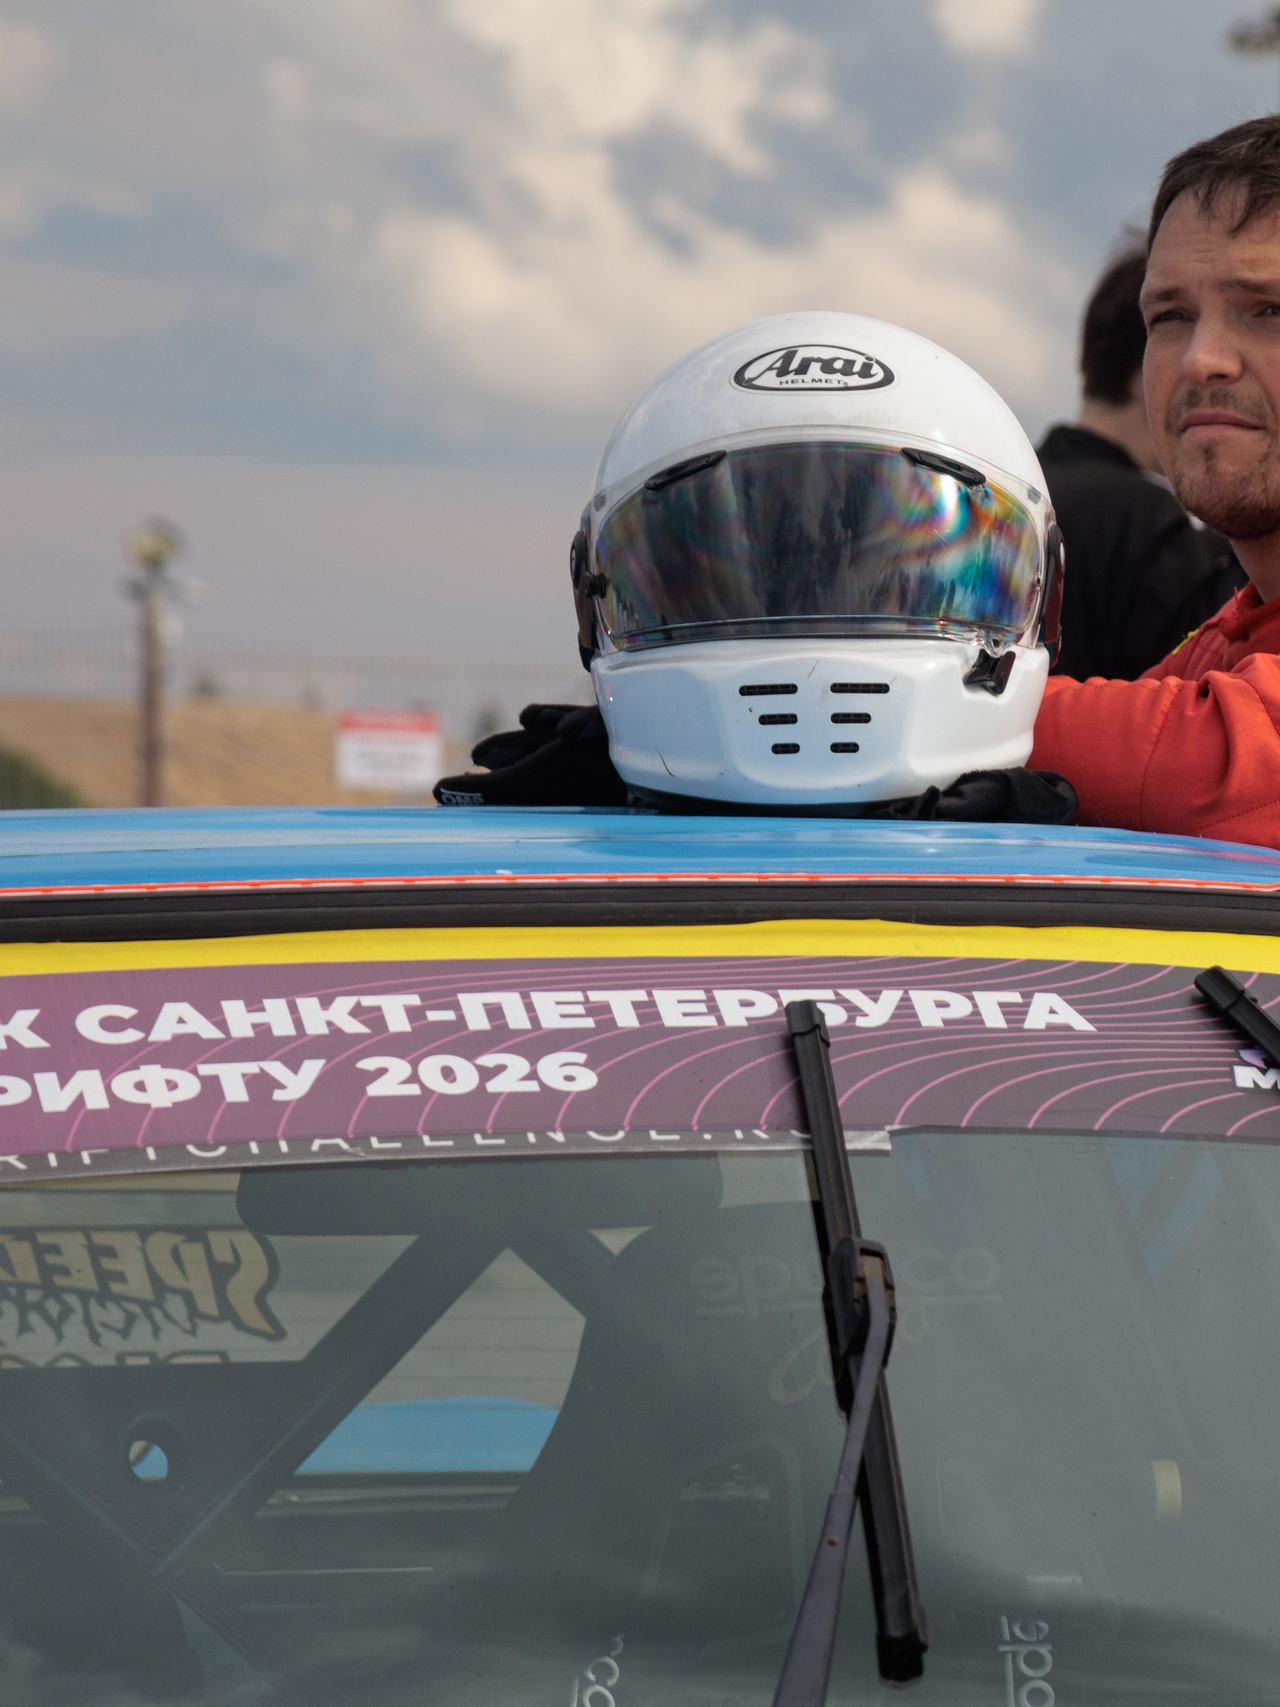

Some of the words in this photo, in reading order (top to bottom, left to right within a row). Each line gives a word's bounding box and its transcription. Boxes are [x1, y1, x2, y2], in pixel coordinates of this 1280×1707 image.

[743, 349, 880, 385] Arai
[779, 378, 844, 387] HELMET
[75, 988, 1098, 1045] САНКТ-ПЕТЕРБУРГА
[356, 1051, 599, 1097] 2026
